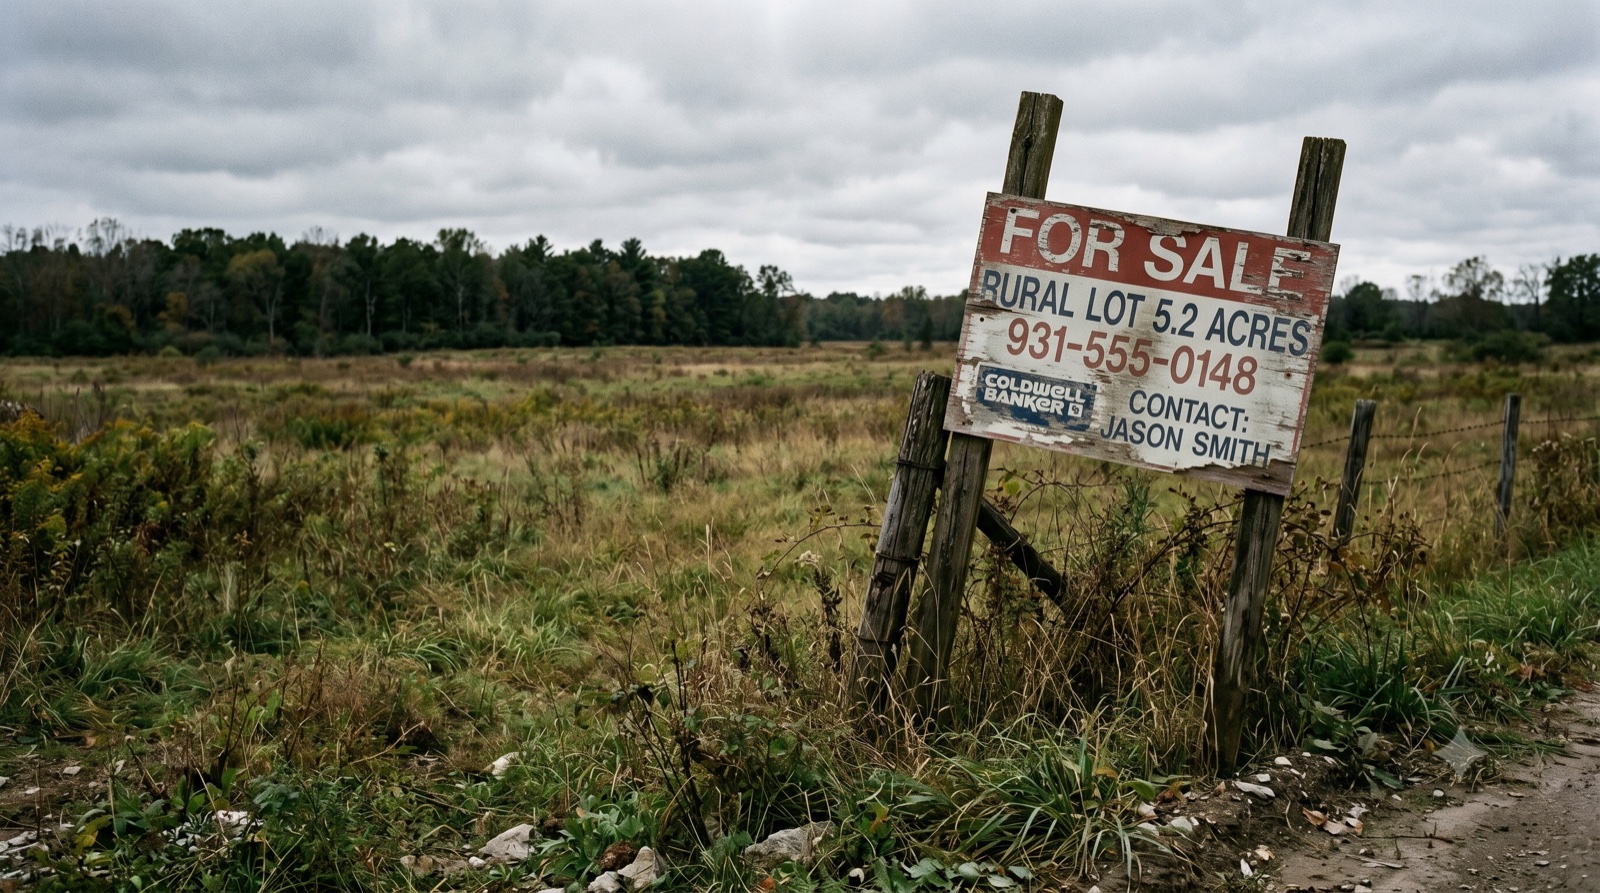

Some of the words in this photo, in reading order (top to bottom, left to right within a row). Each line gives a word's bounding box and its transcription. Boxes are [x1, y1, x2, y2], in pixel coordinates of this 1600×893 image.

[1000, 207, 1125, 272] FOR
[1143, 235, 1312, 301] SALE
[981, 269, 1074, 318] RURAL
[1085, 287, 1146, 328] LOT
[1152, 298, 1198, 338] 5.2
[1205, 307, 1311, 356] ACRES
[1006, 317, 1258, 395] 931-555-0148
[984, 387, 1065, 415] BANKER
[985, 373, 1086, 403] COLDWELL
[1129, 390, 1249, 433] CONTACT:
[1100, 415, 1184, 452] JASON
[1191, 431, 1271, 470] SMITH
